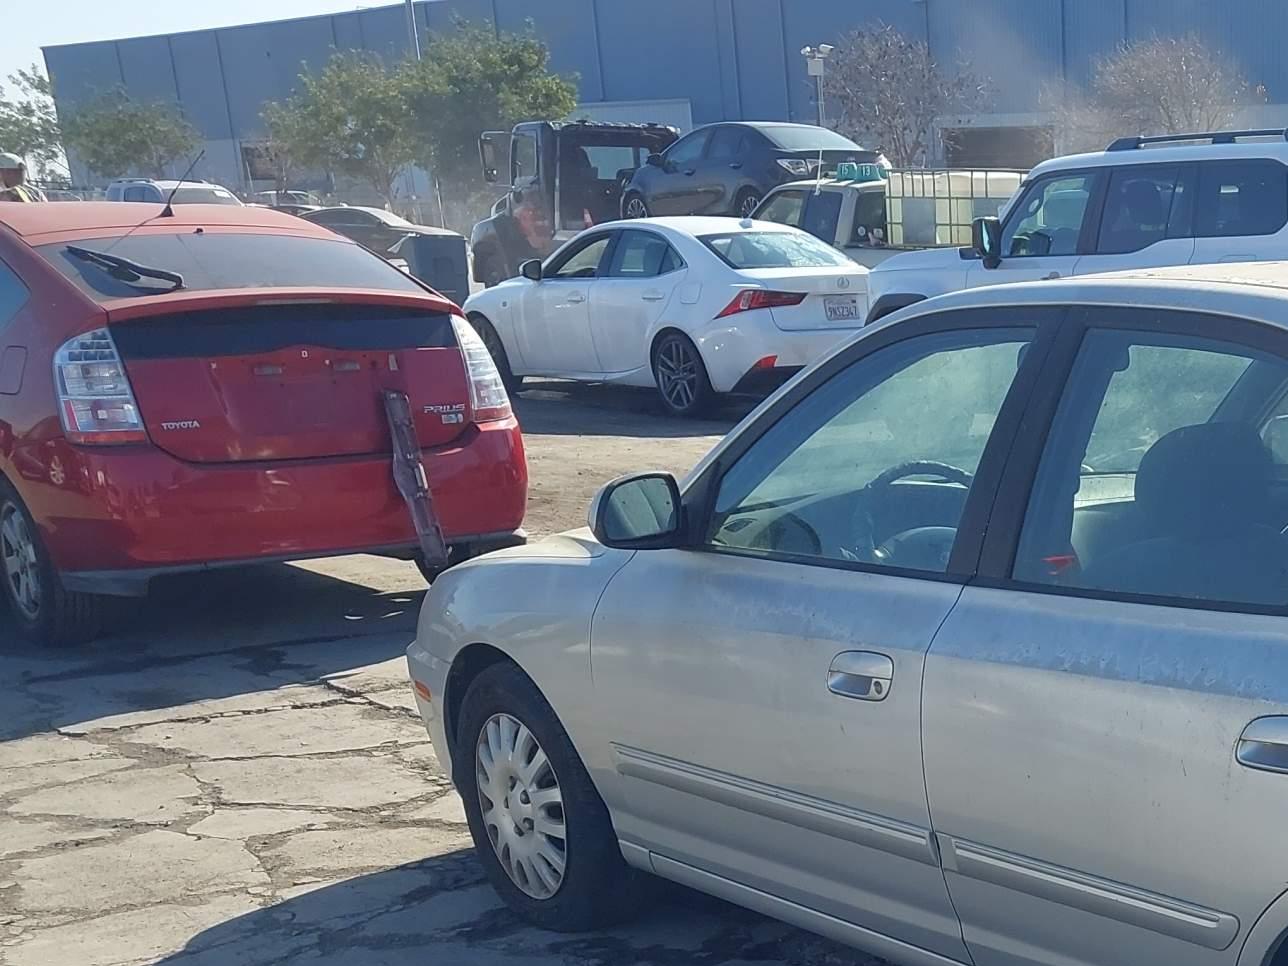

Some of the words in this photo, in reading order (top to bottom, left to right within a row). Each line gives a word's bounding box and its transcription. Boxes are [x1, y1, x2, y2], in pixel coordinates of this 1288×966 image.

[841, 164, 849, 176] 15
[862, 165, 871, 176] 13
[423, 403, 465, 413] PRIUS
[161, 420, 201, 430] TOYOTA
